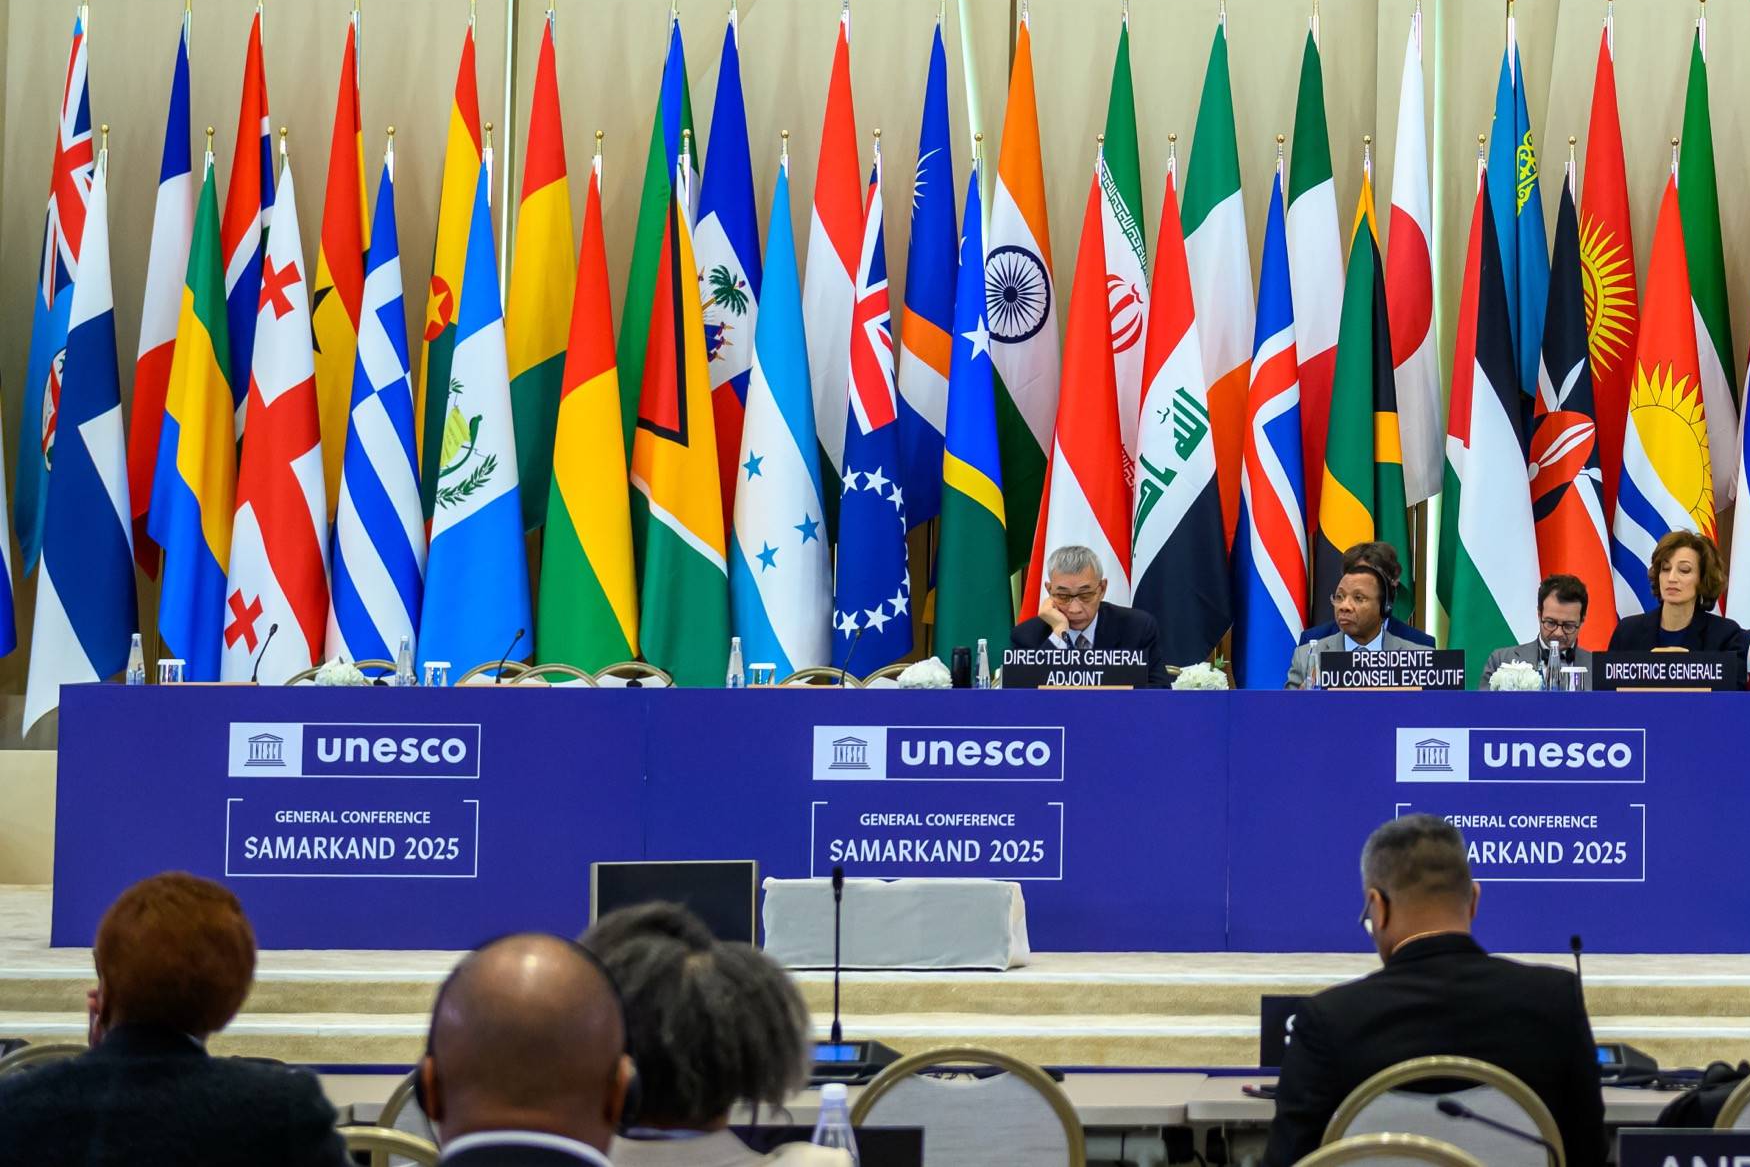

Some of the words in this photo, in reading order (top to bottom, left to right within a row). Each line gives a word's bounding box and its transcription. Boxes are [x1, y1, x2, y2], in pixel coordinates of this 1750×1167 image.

[1003, 649, 1081, 665] DIRECTEUR
[1083, 649, 1147, 666] GENERAL
[1352, 651, 1433, 668] PRESIDENTE
[1046, 670, 1104, 686] ADJOINT
[1321, 670, 1340, 687] DU
[1342, 670, 1399, 686] CONSEIL
[1401, 669, 1464, 686] EXECUTIF
[1605, 663, 1667, 680] DIRECTRICE
[1668, 663, 1723, 680] GENERALE
[317, 737, 467, 764] unesco
[900, 740, 1051, 767] unesco
[1483, 742, 1632, 769] unesco
[275, 811, 338, 824] GENERAL
[340, 811, 431, 824] CONFERENCE
[859, 813, 922, 826] GENERAL
[925, 813, 1016, 827] CONFERENCE
[1508, 815, 1598, 829] CONFERENCE
[244, 836, 396, 860] SAMARKAND
[404, 837, 460, 860] 2025
[829, 839, 981, 863] SAMARKAND
[990, 839, 1045, 863] 2025
[1466, 841, 1564, 864] ARKAND
[1572, 841, 1627, 865] 2025
